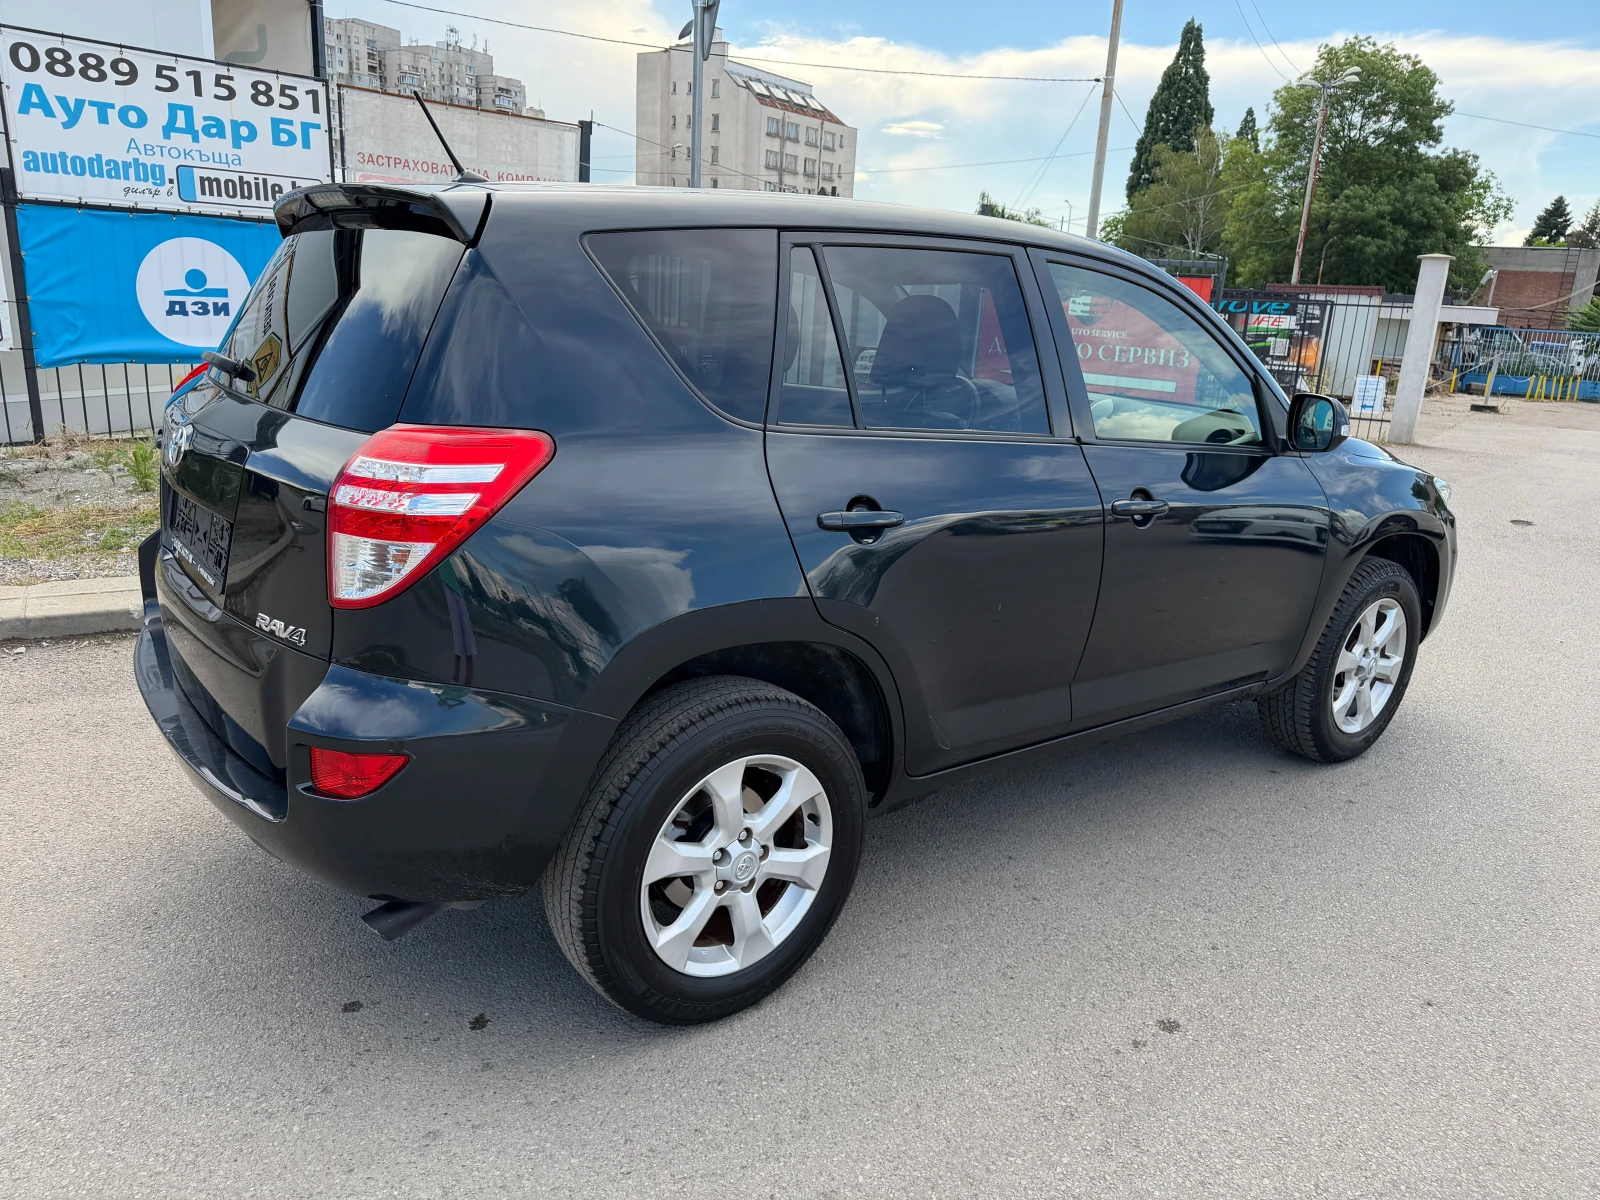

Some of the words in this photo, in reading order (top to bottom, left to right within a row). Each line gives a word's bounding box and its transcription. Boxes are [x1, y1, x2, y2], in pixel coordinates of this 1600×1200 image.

[9, 41, 139, 86] 0889
[154, 64, 237, 102] 515
[250, 80, 320, 114] 851
[17, 82, 148, 130] Ауто
[162, 102, 258, 150] Дар
[270, 117, 322, 150] БГ
[126, 138, 242, 167] Автокъща
[165, 300, 230, 316] ДЗИ
[1070, 328, 1090, 337] UTO
[1091, 329, 1128, 339] SERVICE
[1098, 344, 1190, 368] СЕРВИЗ
[255, 612, 307, 647] RAV4
